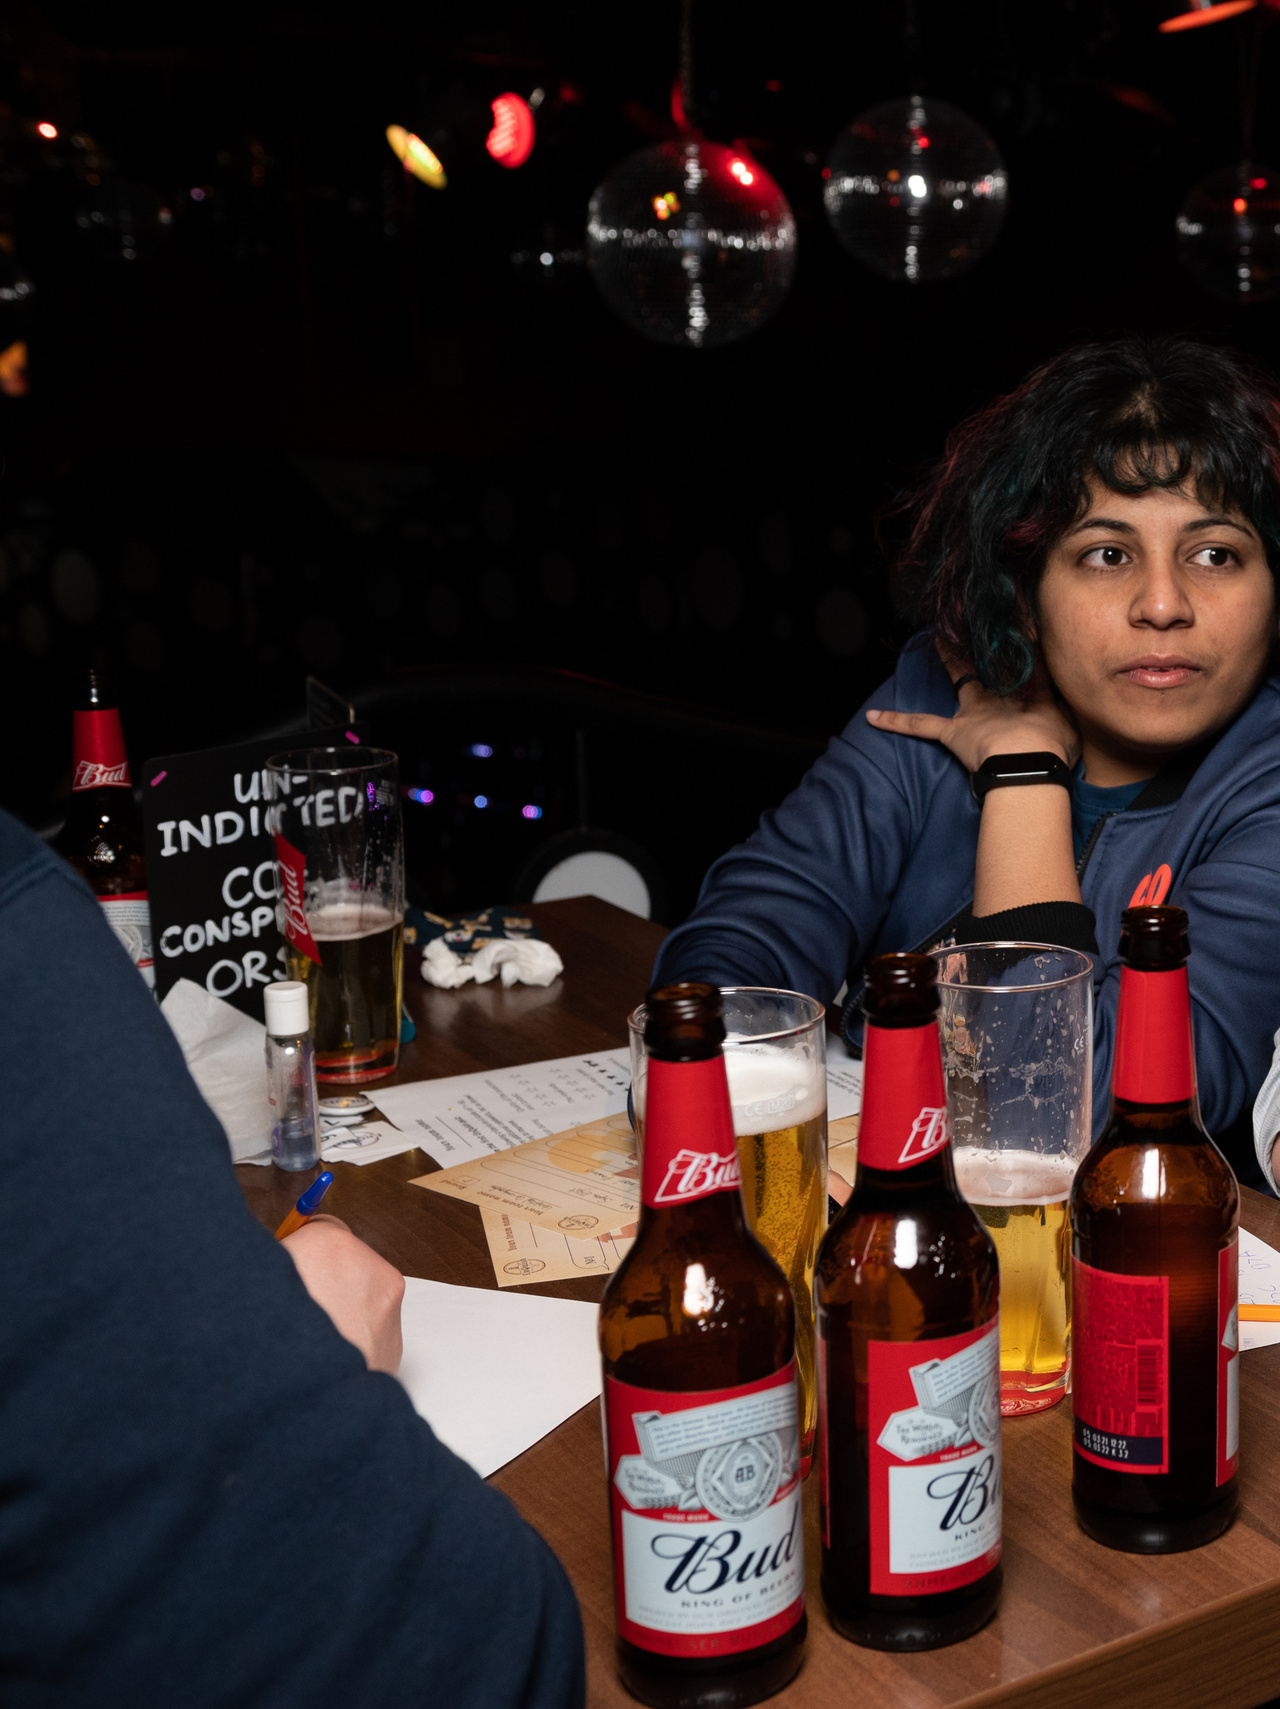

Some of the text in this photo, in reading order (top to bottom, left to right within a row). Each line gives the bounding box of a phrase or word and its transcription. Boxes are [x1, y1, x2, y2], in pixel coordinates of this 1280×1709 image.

[76, 763, 126, 786] Bud
[285, 863, 309, 942] Bud
[651, 1500, 800, 1594] Bud
[681, 1599, 724, 1609] KING
[732, 1593, 753, 1604] OF
